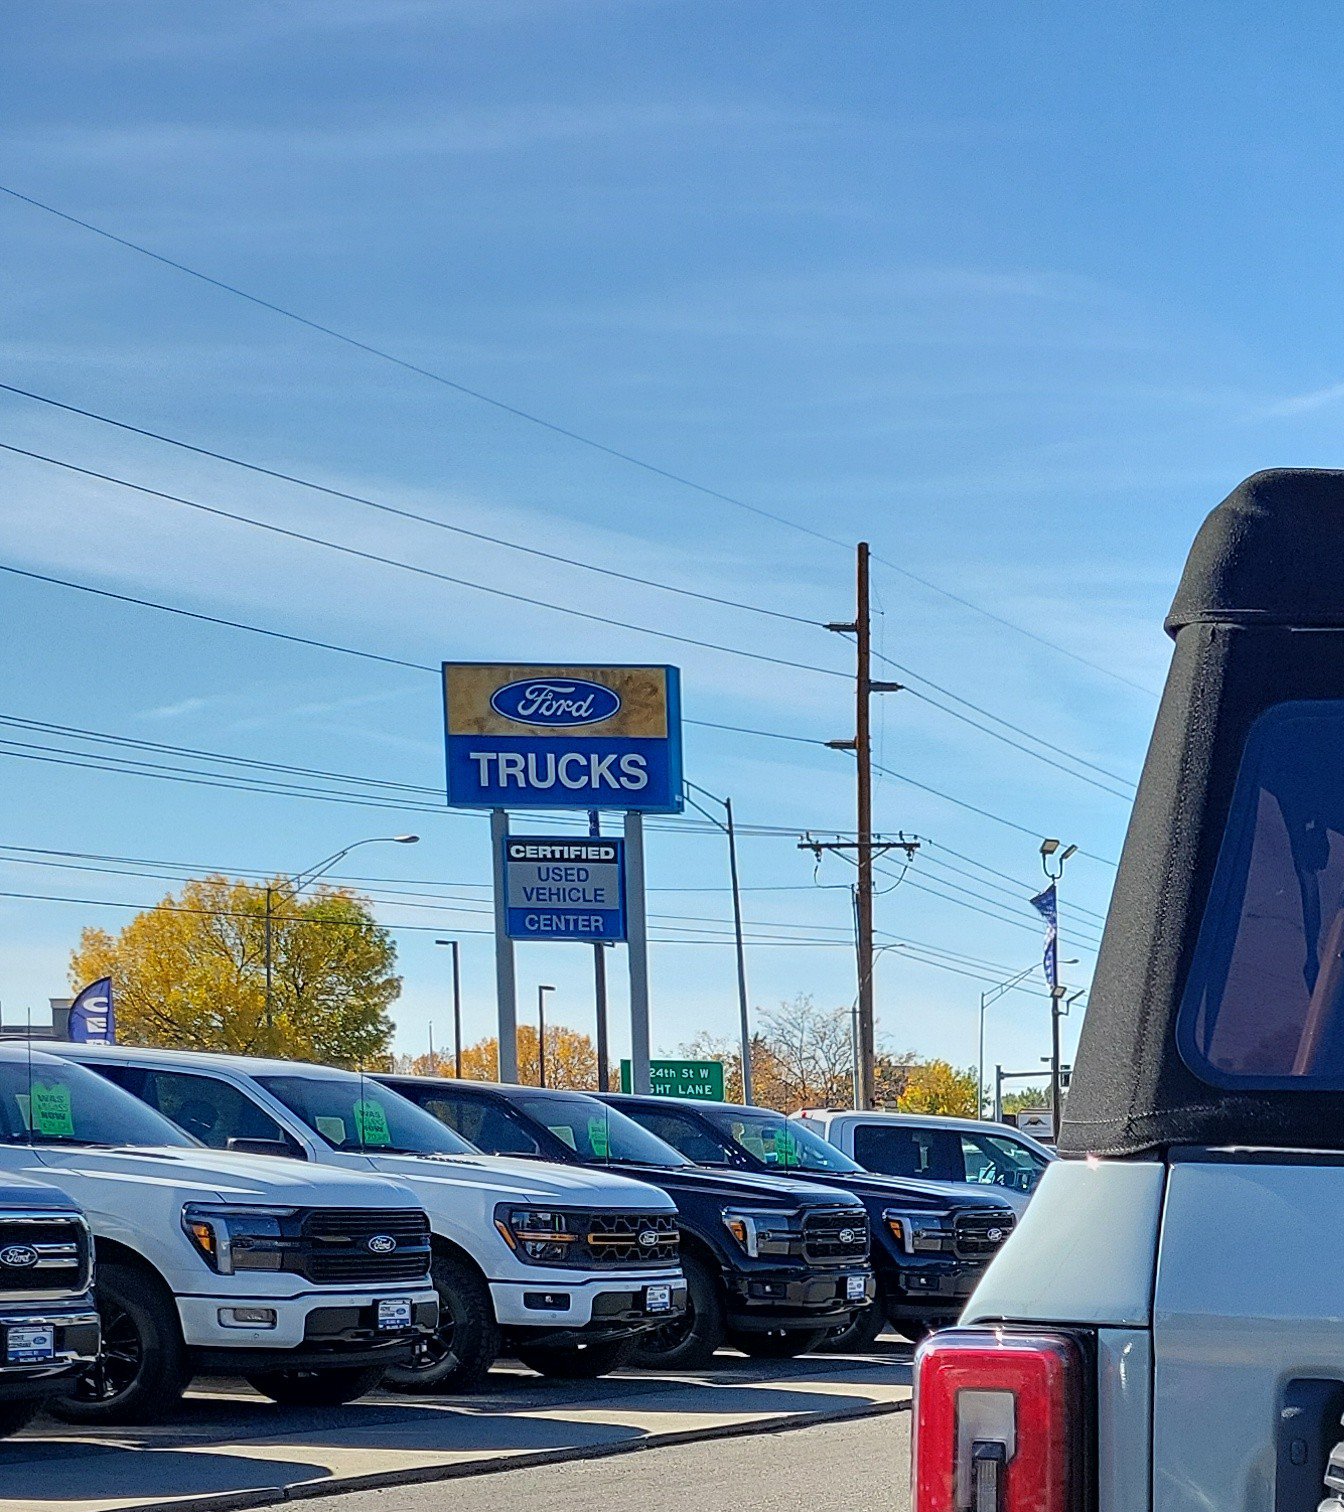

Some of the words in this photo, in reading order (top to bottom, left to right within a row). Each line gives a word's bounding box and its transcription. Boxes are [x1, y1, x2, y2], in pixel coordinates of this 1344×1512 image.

[518, 684, 595, 718] Ford
[469, 752, 648, 790] TRUCKS
[510, 845, 615, 860] CERTIFIED
[537, 866, 589, 883] USED
[523, 887, 605, 903] VEHICLE
[525, 915, 604, 932] CENTER
[650, 1068, 677, 1078] 24th
[681, 1068, 694, 1078] St
[700, 1069, 709, 1078] W
[678, 1085, 713, 1095] LANE
